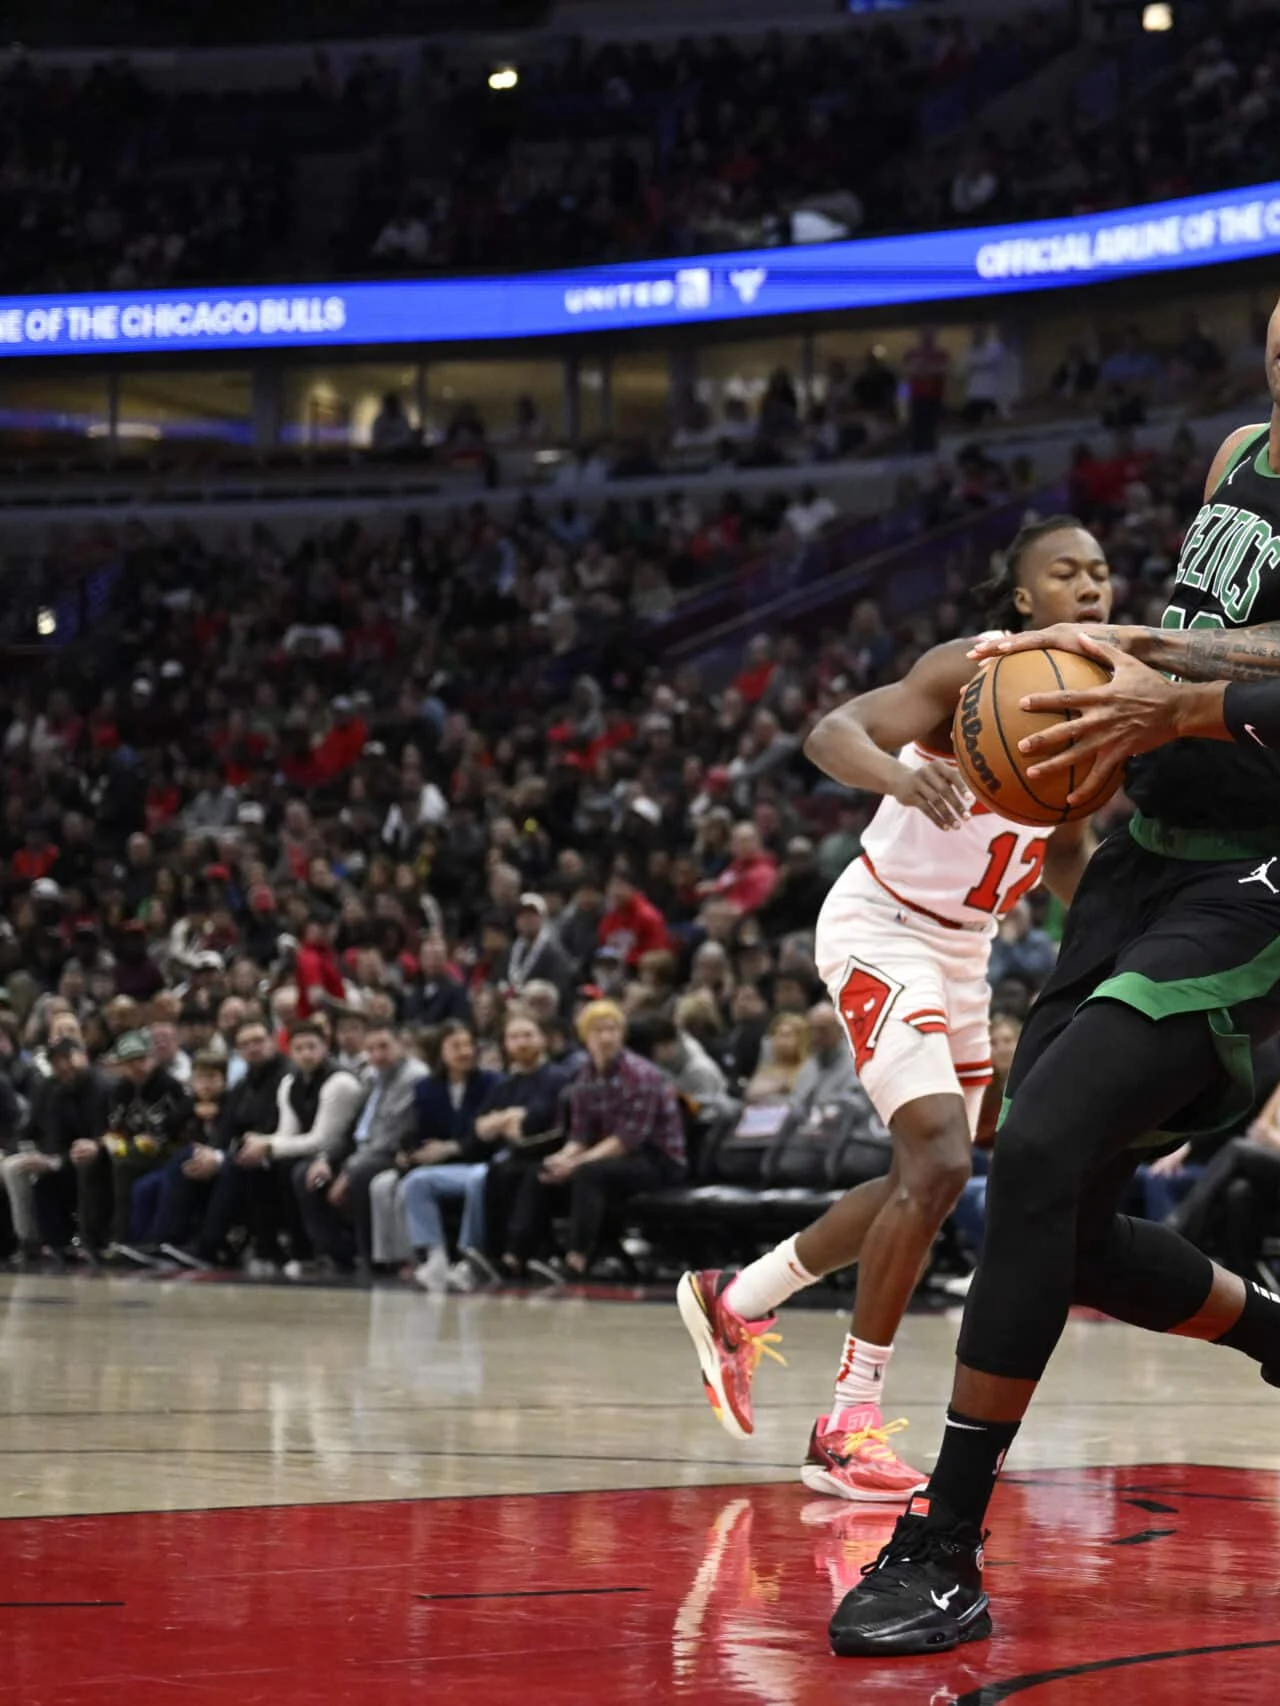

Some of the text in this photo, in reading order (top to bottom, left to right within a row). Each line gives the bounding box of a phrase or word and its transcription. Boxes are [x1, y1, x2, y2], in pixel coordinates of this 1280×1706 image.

[565, 279, 674, 314] UNITED
[25, 308, 63, 342] OF
[66, 305, 119, 341] THE
[121, 301, 257, 338] CHICAGO
[259, 297, 346, 333] BULLS
[963, 830, 1047, 914] 12
